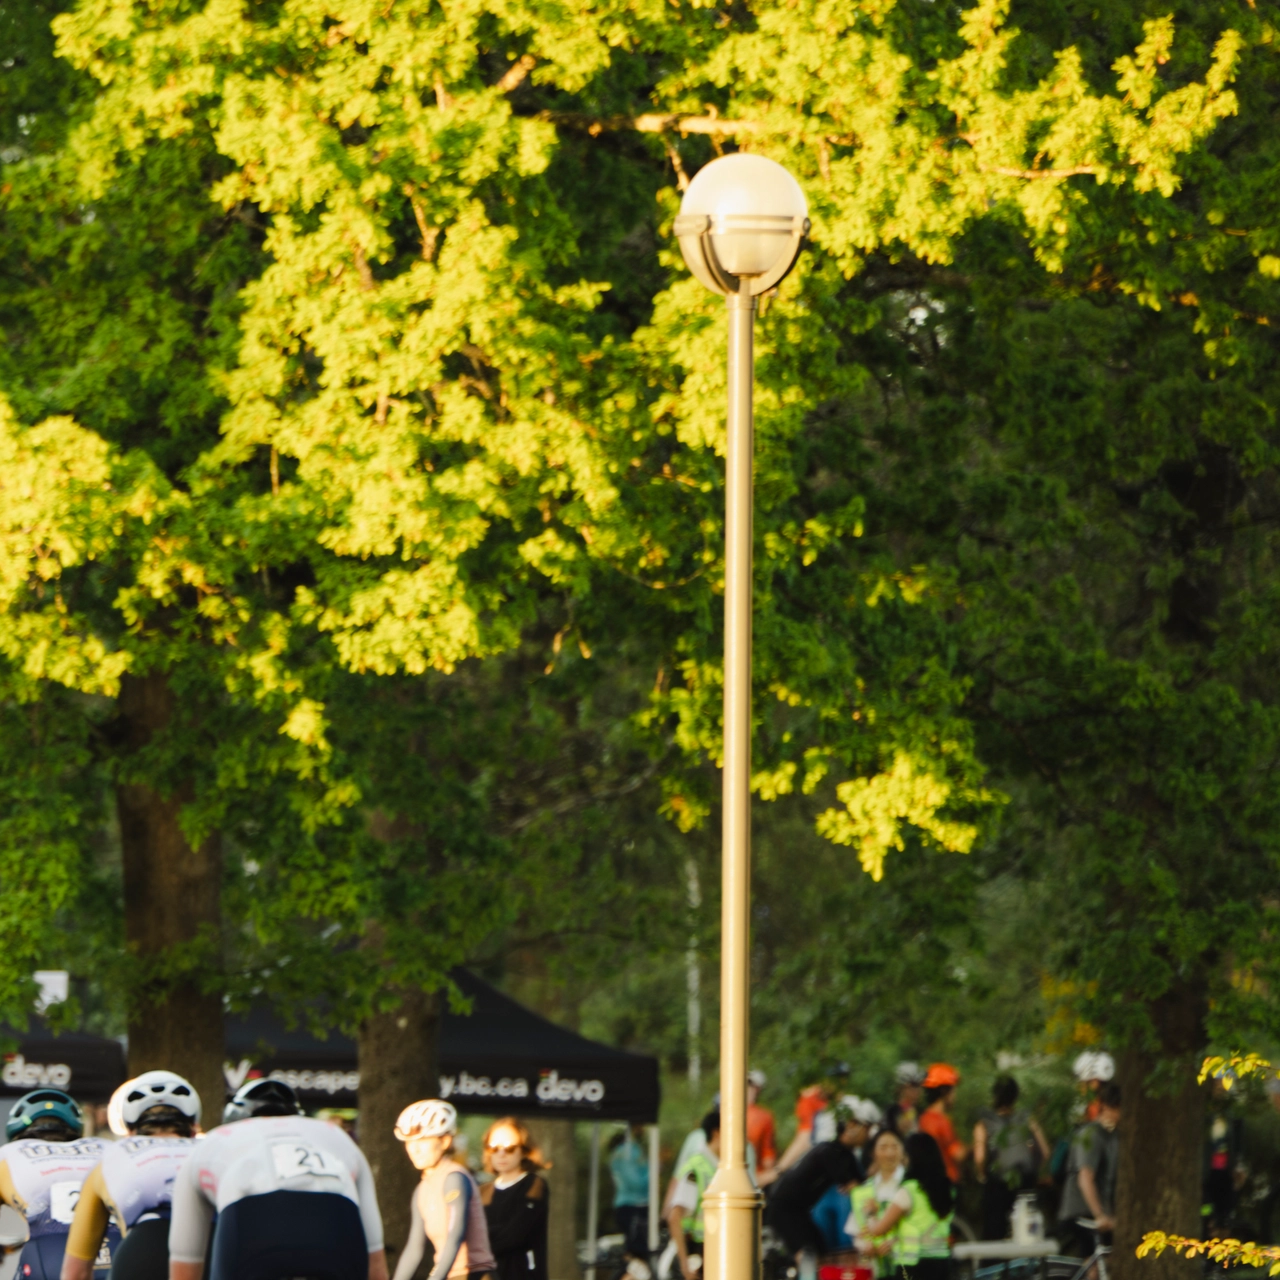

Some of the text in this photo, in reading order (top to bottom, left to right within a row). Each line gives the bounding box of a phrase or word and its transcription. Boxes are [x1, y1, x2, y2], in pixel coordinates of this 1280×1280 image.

[2, 1054, 71, 1087] devo
[536, 1069, 605, 1102] devo
[295, 1147, 325, 1169] 21
